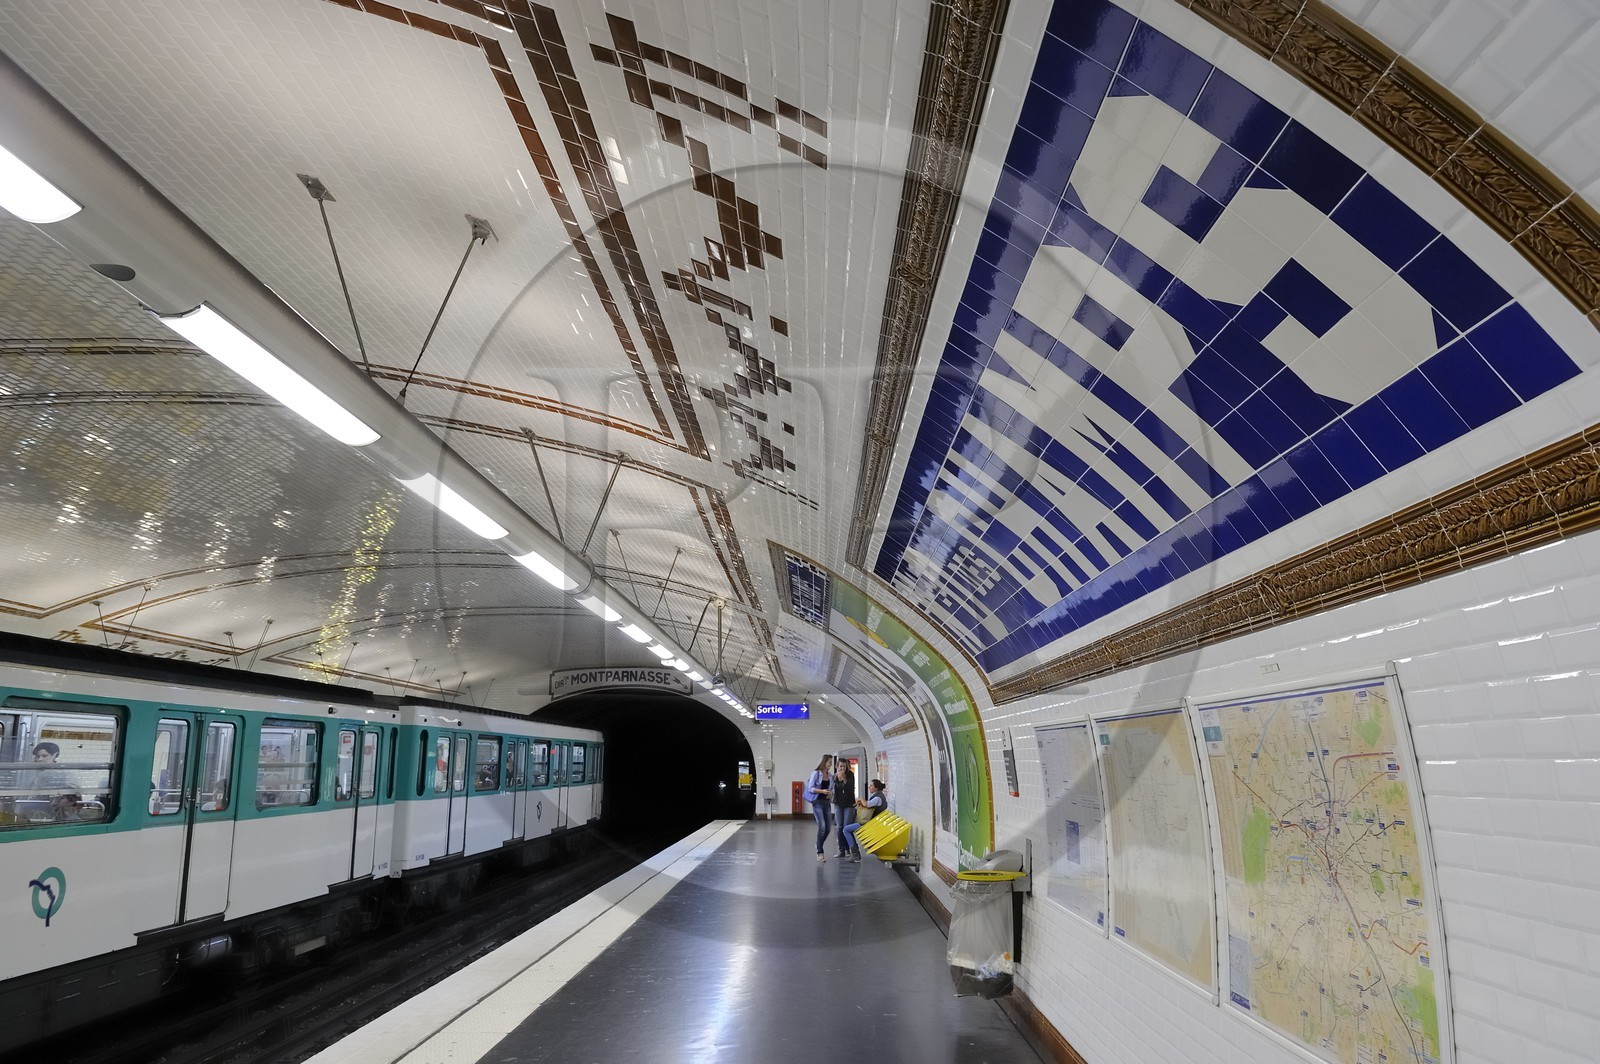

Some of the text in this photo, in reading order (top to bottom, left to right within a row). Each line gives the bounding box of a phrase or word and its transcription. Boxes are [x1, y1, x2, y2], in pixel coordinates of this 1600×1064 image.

[925, 94, 1439, 608] CHAMPS
[947, 546, 1002, 596] DES
[571, 670, 671, 686] MONTPARNASSE
[757, 705, 783, 714] Sortie
